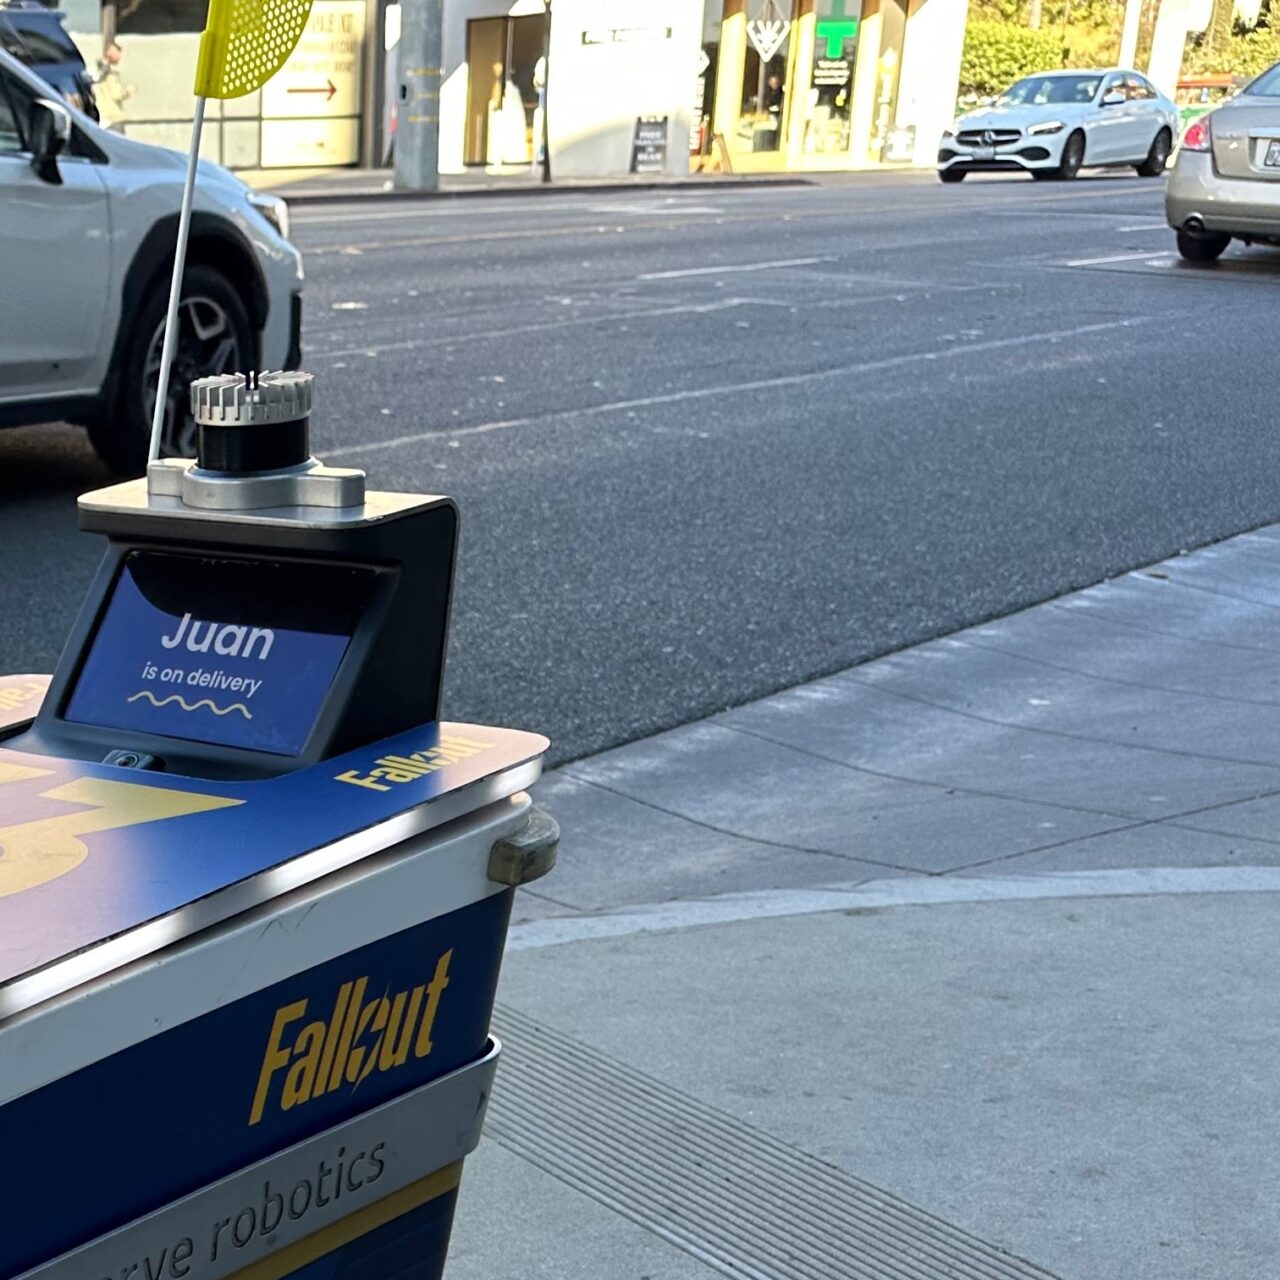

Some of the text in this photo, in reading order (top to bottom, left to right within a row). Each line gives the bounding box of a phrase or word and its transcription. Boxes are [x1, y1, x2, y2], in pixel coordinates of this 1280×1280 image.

[161, 613, 274, 660] Juan
[141, 661, 262, 698] is on delivery
[333, 735, 496, 792] Fallout
[248, 947, 454, 1126] Fallout
[209, 1141, 386, 1262] robotics
